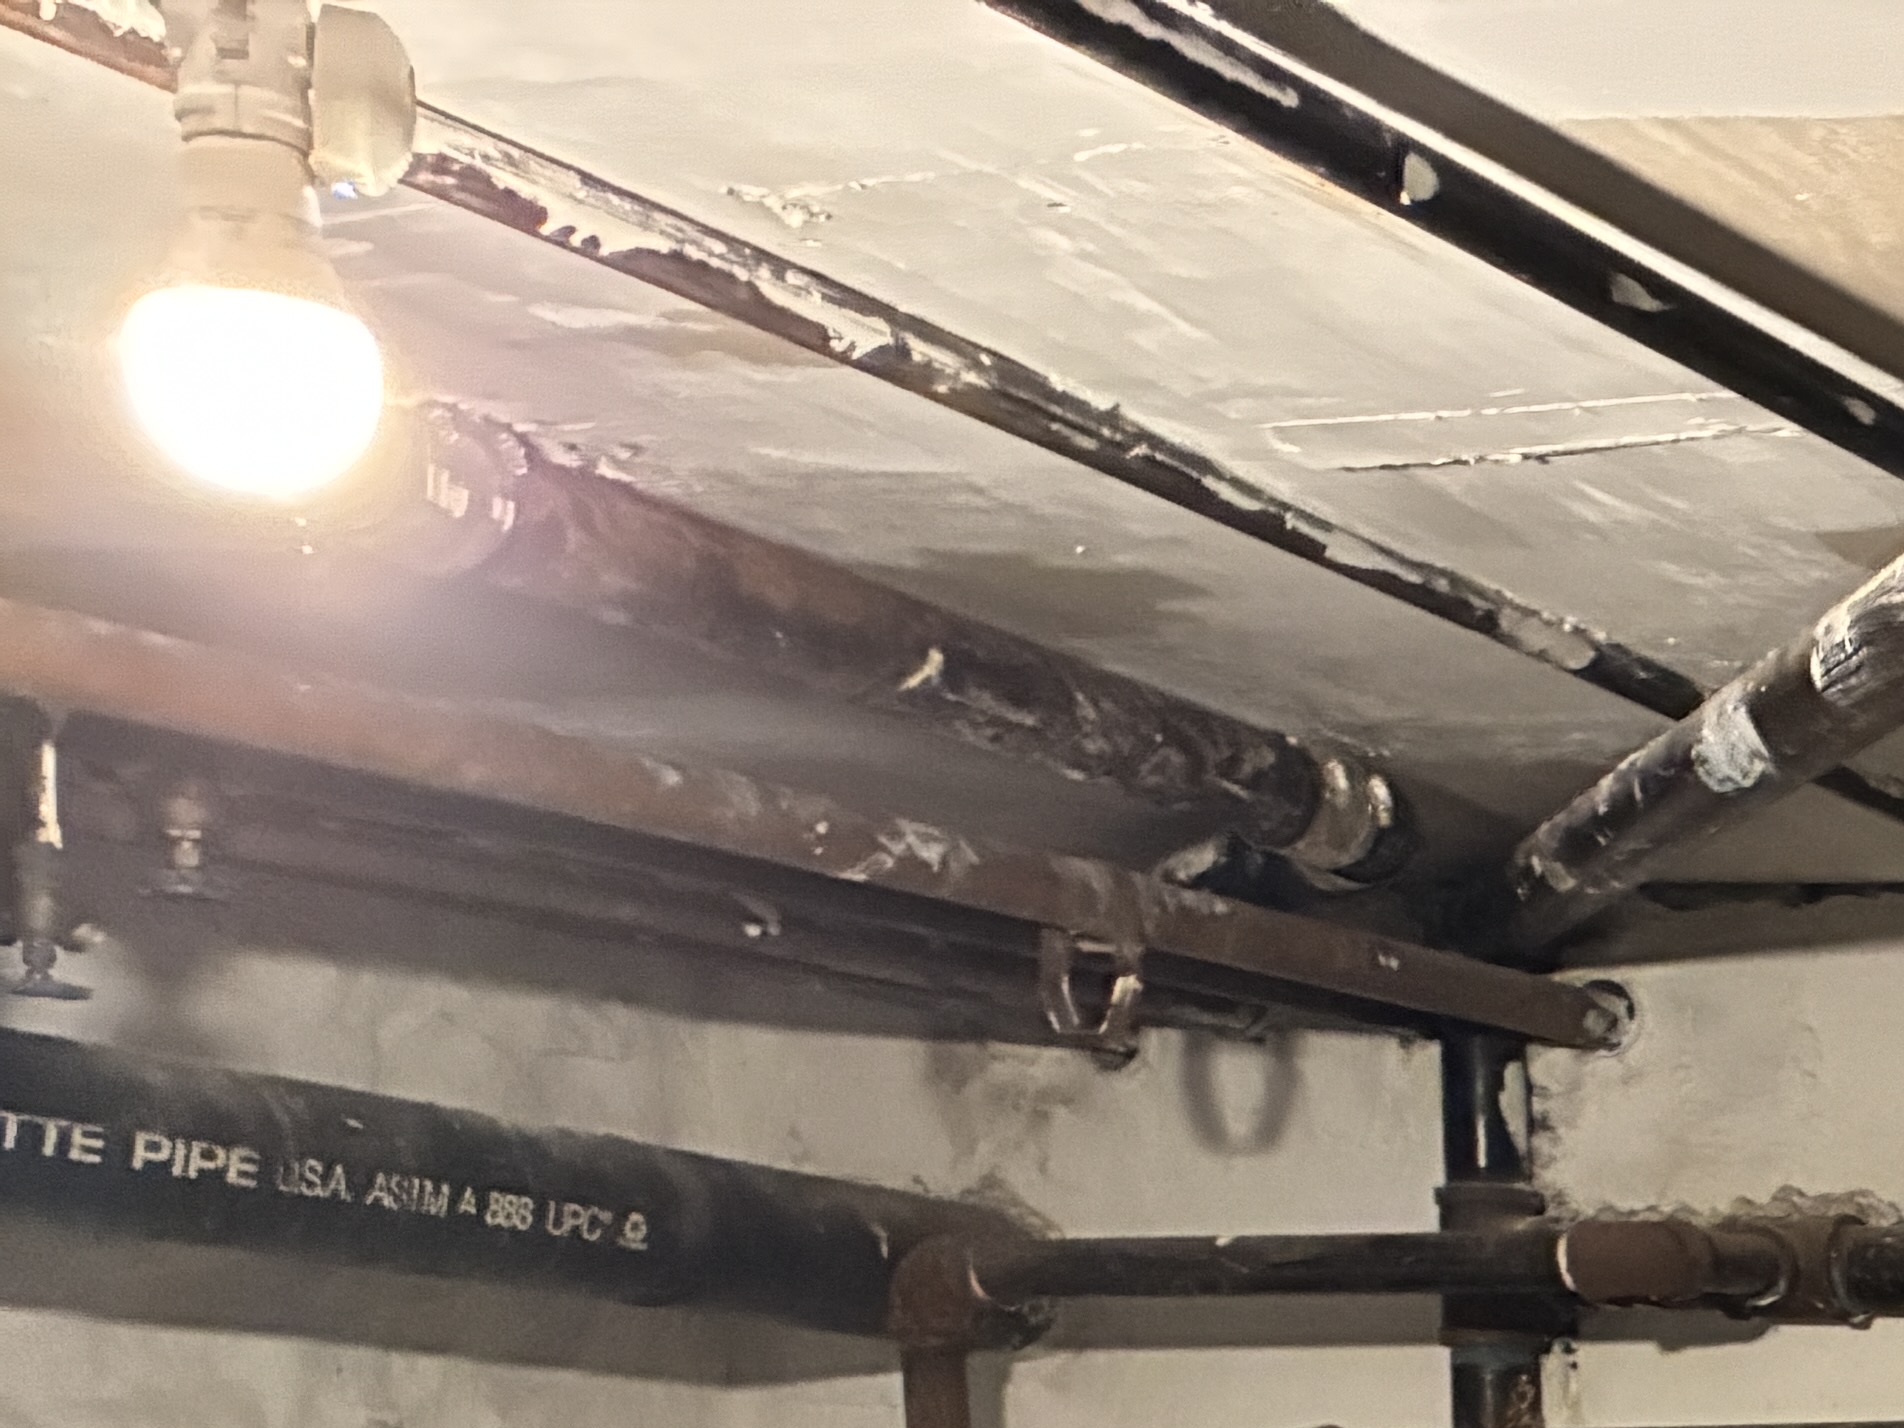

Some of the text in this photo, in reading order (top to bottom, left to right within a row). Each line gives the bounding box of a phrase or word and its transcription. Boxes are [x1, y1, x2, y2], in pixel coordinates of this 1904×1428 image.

[130, 1129, 261, 1189] PIPE
[457, 1185, 477, 1215] A
[483, 1190, 535, 1232] 888
